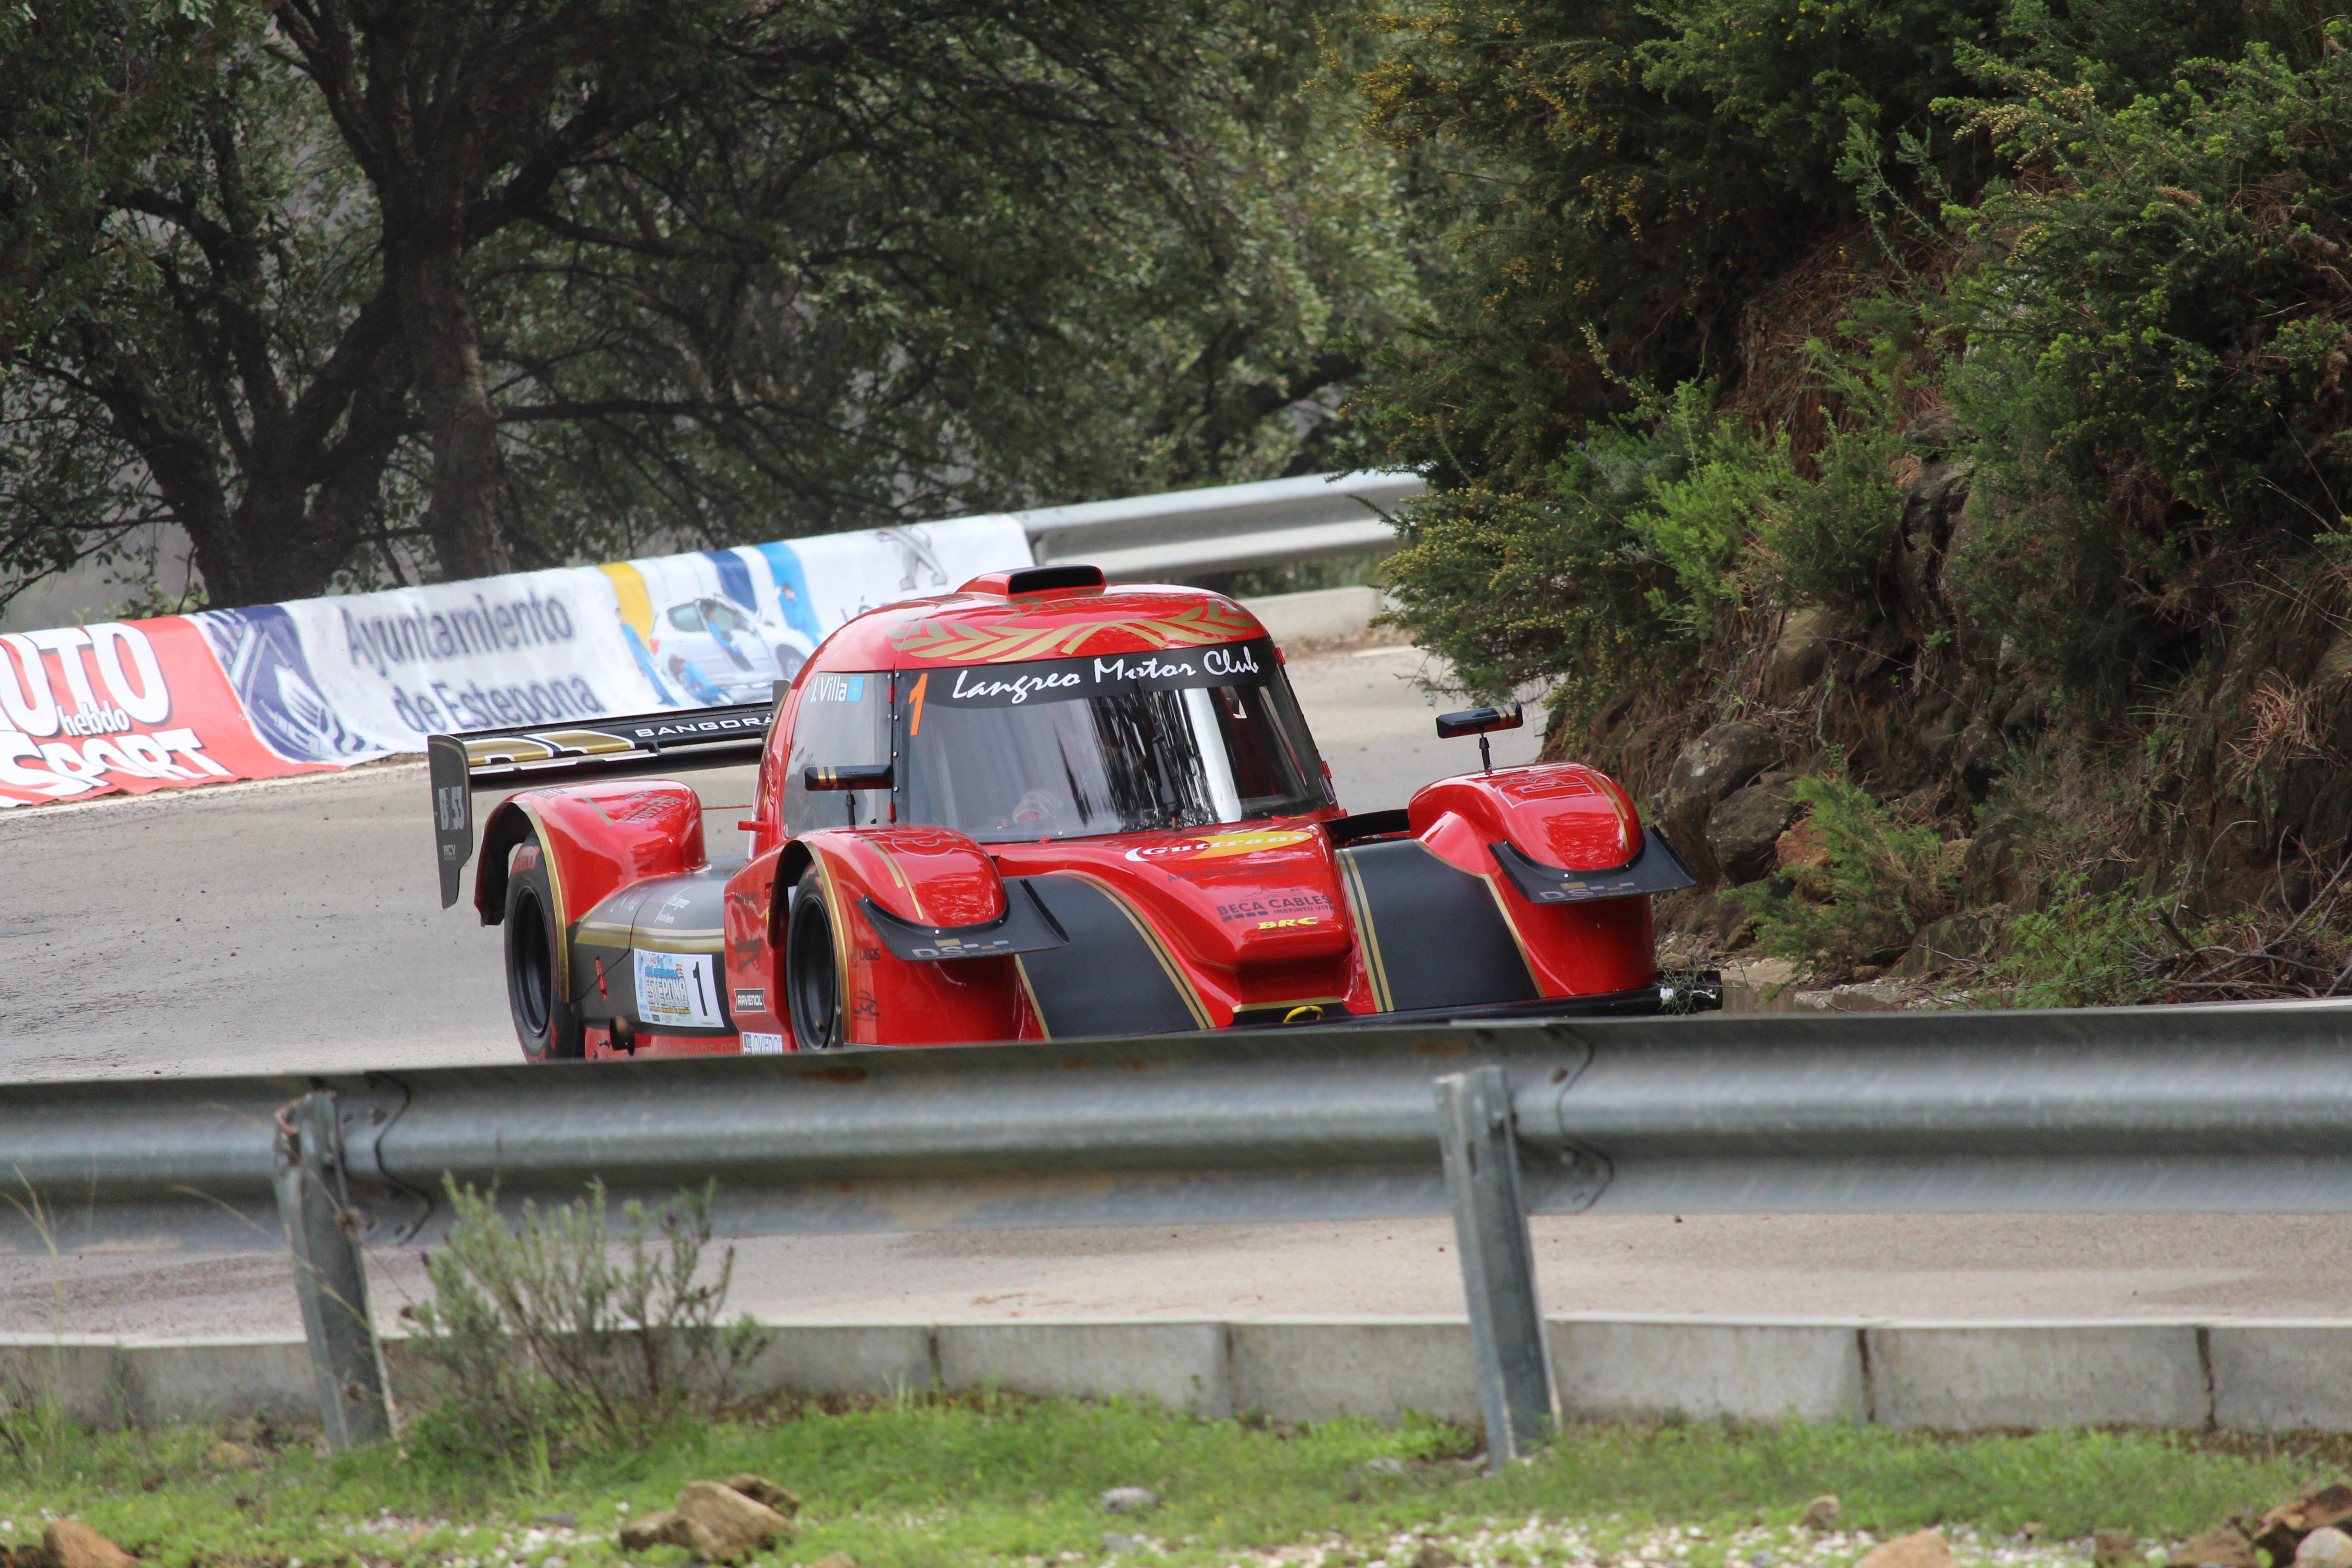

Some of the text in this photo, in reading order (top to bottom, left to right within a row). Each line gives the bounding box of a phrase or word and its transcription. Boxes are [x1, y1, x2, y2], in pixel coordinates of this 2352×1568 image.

[340, 589, 573, 677] Ayuntamiento
[0, 622, 170, 737] UTO
[953, 670, 1081, 704] Langreo
[1203, 647, 1259, 676] Club
[57, 699, 132, 737] hebdo
[393, 673, 605, 733] de Estepona
[908, 673, 928, 736] 1
[1142, 835, 1305, 855] Guttrans
[1217, 902, 1265, 916] BECA
[1269, 895, 1333, 908] CABLES
[1258, 916, 1318, 930] BRC
[1274, 906, 1313, 914] INSTINTO
[692, 961, 708, 1017] 1
[737, 995, 763, 1006] RAVENOL
